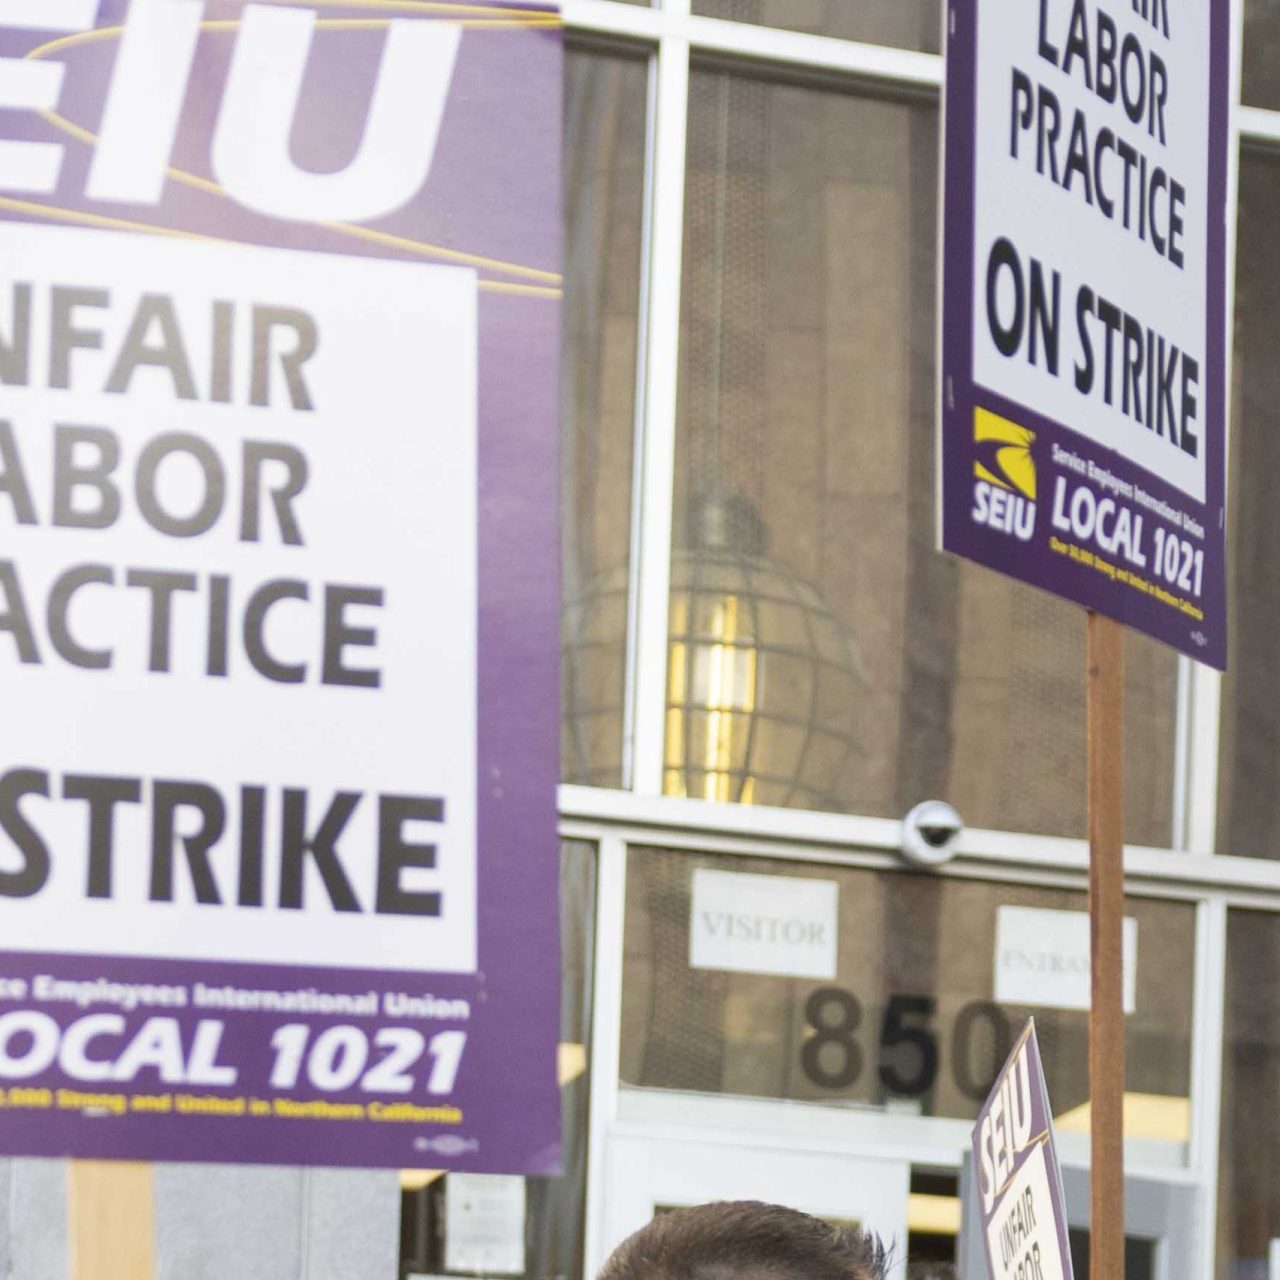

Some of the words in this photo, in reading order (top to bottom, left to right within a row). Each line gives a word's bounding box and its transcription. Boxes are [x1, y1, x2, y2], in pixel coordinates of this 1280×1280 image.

[1038, 0, 1168, 146] LABOR
[1010, 66, 1186, 270] PRACTICE
[986, 236, 1061, 378] ON
[1073, 284, 1199, 459] STRIKE
[972, 481, 1037, 541] SEIU
[1052, 476, 1146, 568] LOCAL
[1154, 526, 1204, 597] 1021
[0, 767, 444, 917] STRIKE
[700, 909, 828, 946] VISITOR
[268, 1022, 467, 1094] 1021
[383, 991, 471, 1019] Union
[801, 987, 1010, 1103] 850
[980, 1043, 1032, 1215] SEIU
[1000, 1185, 1037, 1272] UNFAIR
